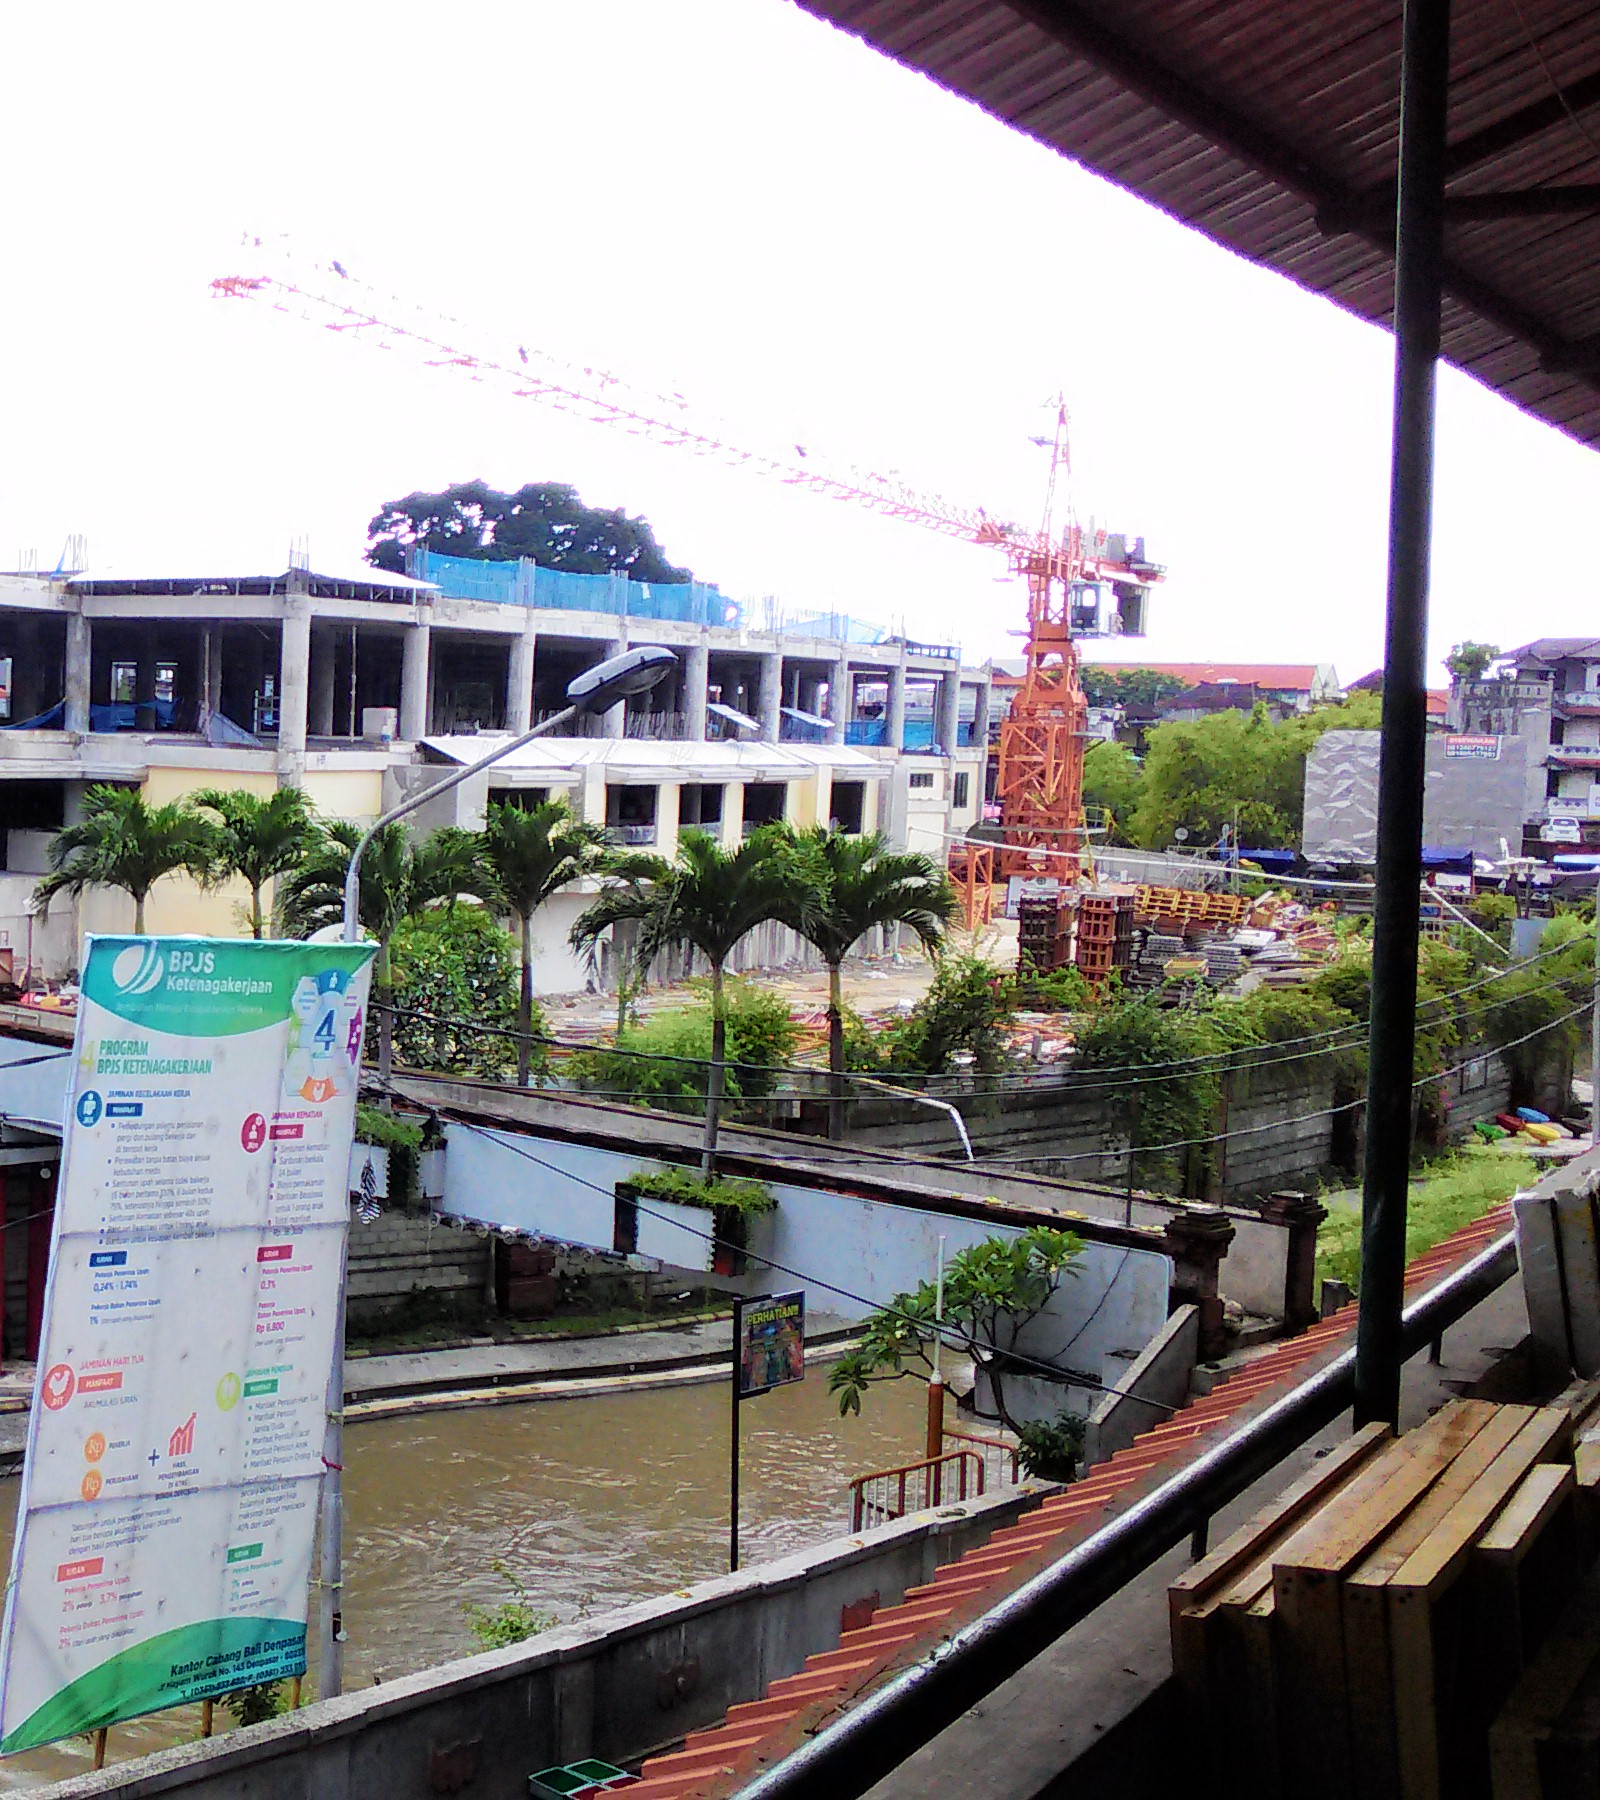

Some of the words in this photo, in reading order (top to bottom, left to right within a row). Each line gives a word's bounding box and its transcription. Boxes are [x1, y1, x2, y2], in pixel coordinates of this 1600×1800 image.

[169, 951, 215, 973] BPJS
[167, 975, 272, 995] Ketenagakerjaan
[100, 1040, 149, 1056] PROGRAM
[97, 1059, 121, 1074] BPJS
[122, 1059, 212, 1074] KETENAGAKERJAAN
[80, 1359, 112, 1370] JAMINAN
[131, 1354, 144, 1363] TUA
[85, 1378, 114, 1388] MANFAAT
[89, 1439, 103, 1456] Rp
[171, 1660, 204, 1676] Kantor
[206, 1650, 242, 1668] Cabang
[244, 1643, 262, 1658] Bali
[264, 1634, 305, 1651] Denpasar
[193, 1670, 217, 1682] Wuruk
[219, 1666, 231, 1676] No.
[246, 1655, 279, 1669] Denpasar
